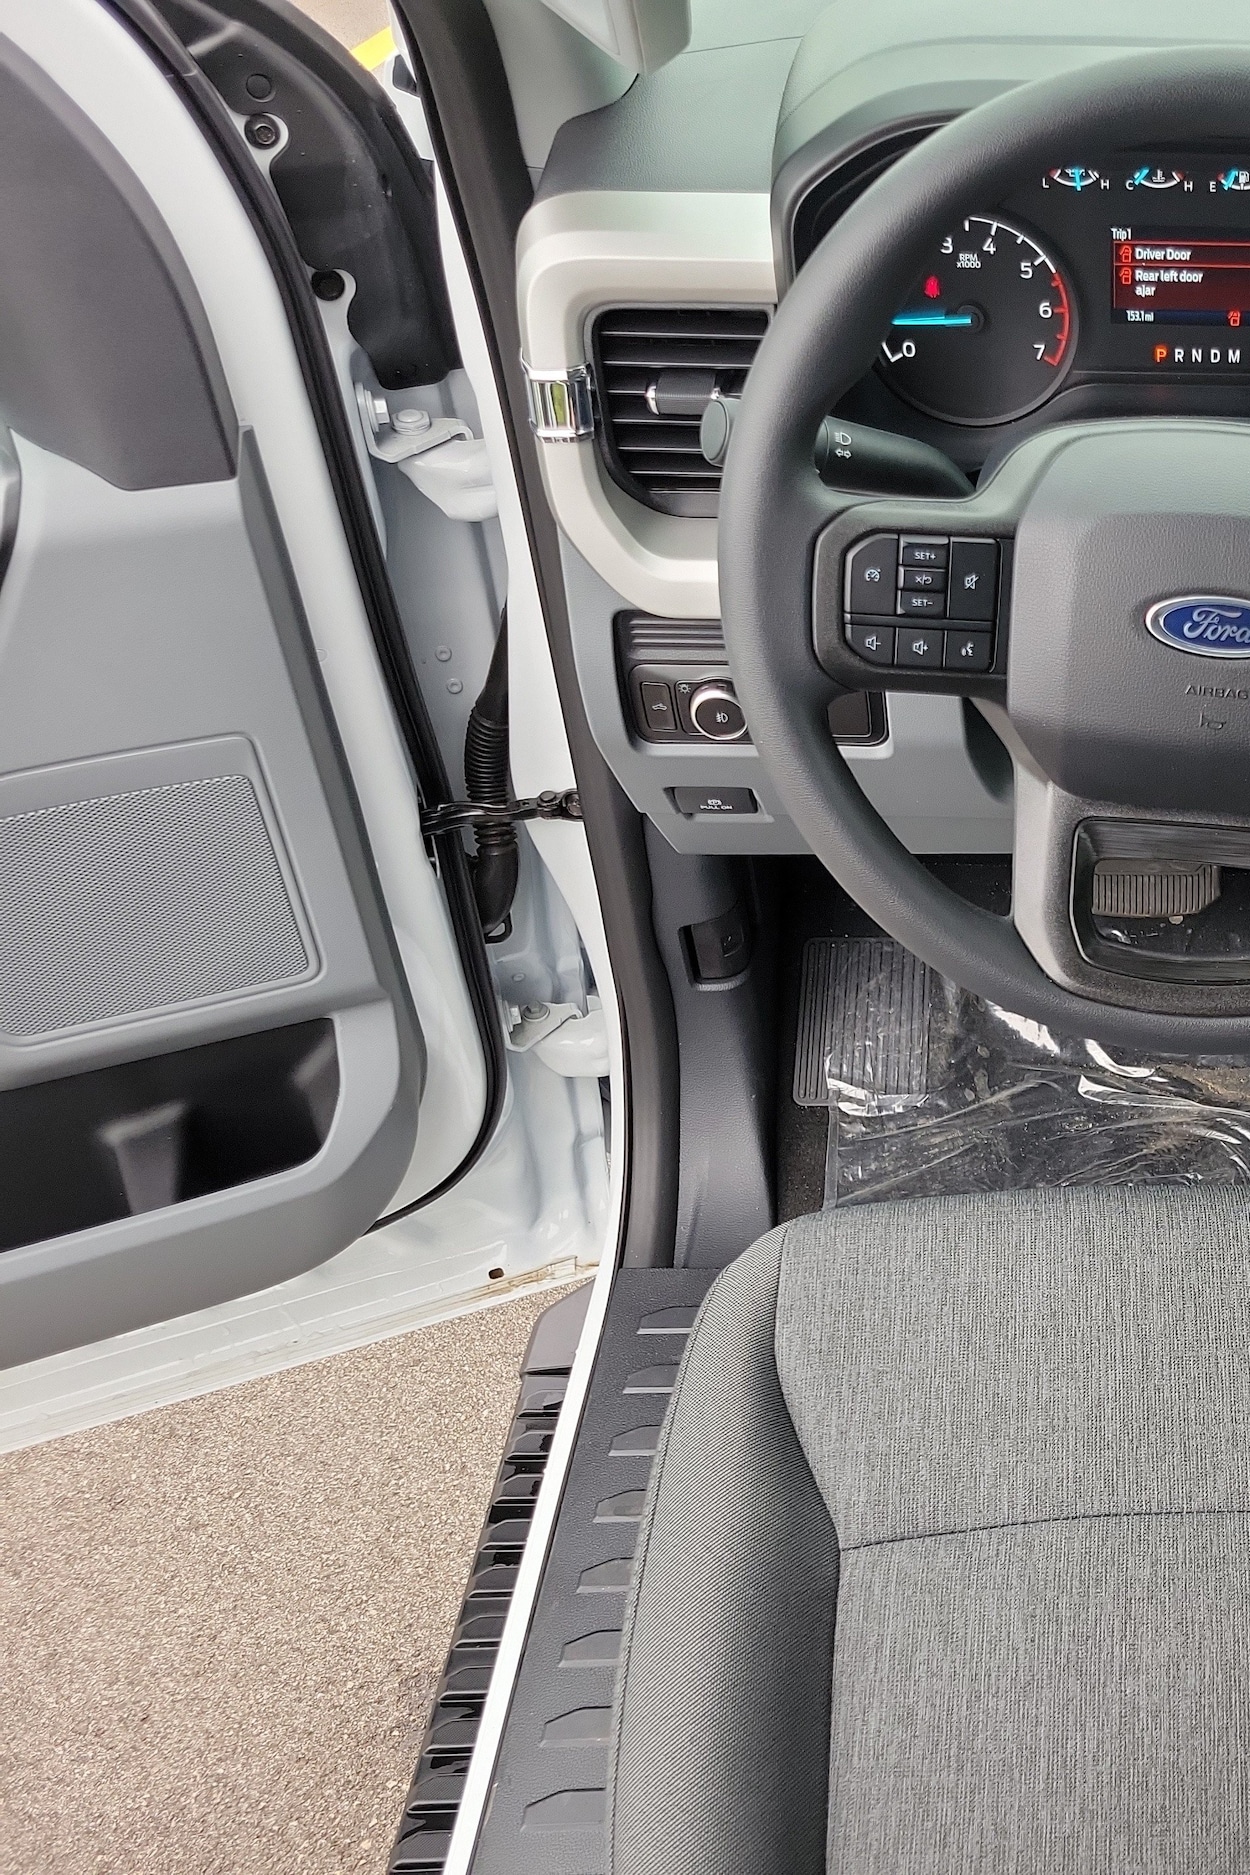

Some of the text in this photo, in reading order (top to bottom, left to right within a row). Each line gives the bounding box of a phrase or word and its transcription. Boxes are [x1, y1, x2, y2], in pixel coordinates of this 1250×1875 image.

[1042, 178, 1050, 189] L
[1101, 180, 1110, 190] H
[1125, 181, 1134, 191] C
[1184, 182, 1193, 192] H
[1209, 182, 1217, 192] E
[1111, 228, 1126, 240] Trip
[940, 236, 954, 254] 3
[982, 237, 996, 255] 4
[959, 253, 979, 261] RPM
[1135, 247, 1191, 261] Driver Door
[956, 261, 981, 269] x1000
[1020, 261, 1033, 279] 5
[1135, 270, 1203, 283] Rear left door
[1135, 285, 1156, 298] ajar
[1039, 302, 1052, 319] 6
[902, 341, 916, 358] 0
[1033, 343, 1046, 361] 7
[1156, 348, 1241, 363] P R N D M
[1184, 684, 1249, 700] AIRBAG
